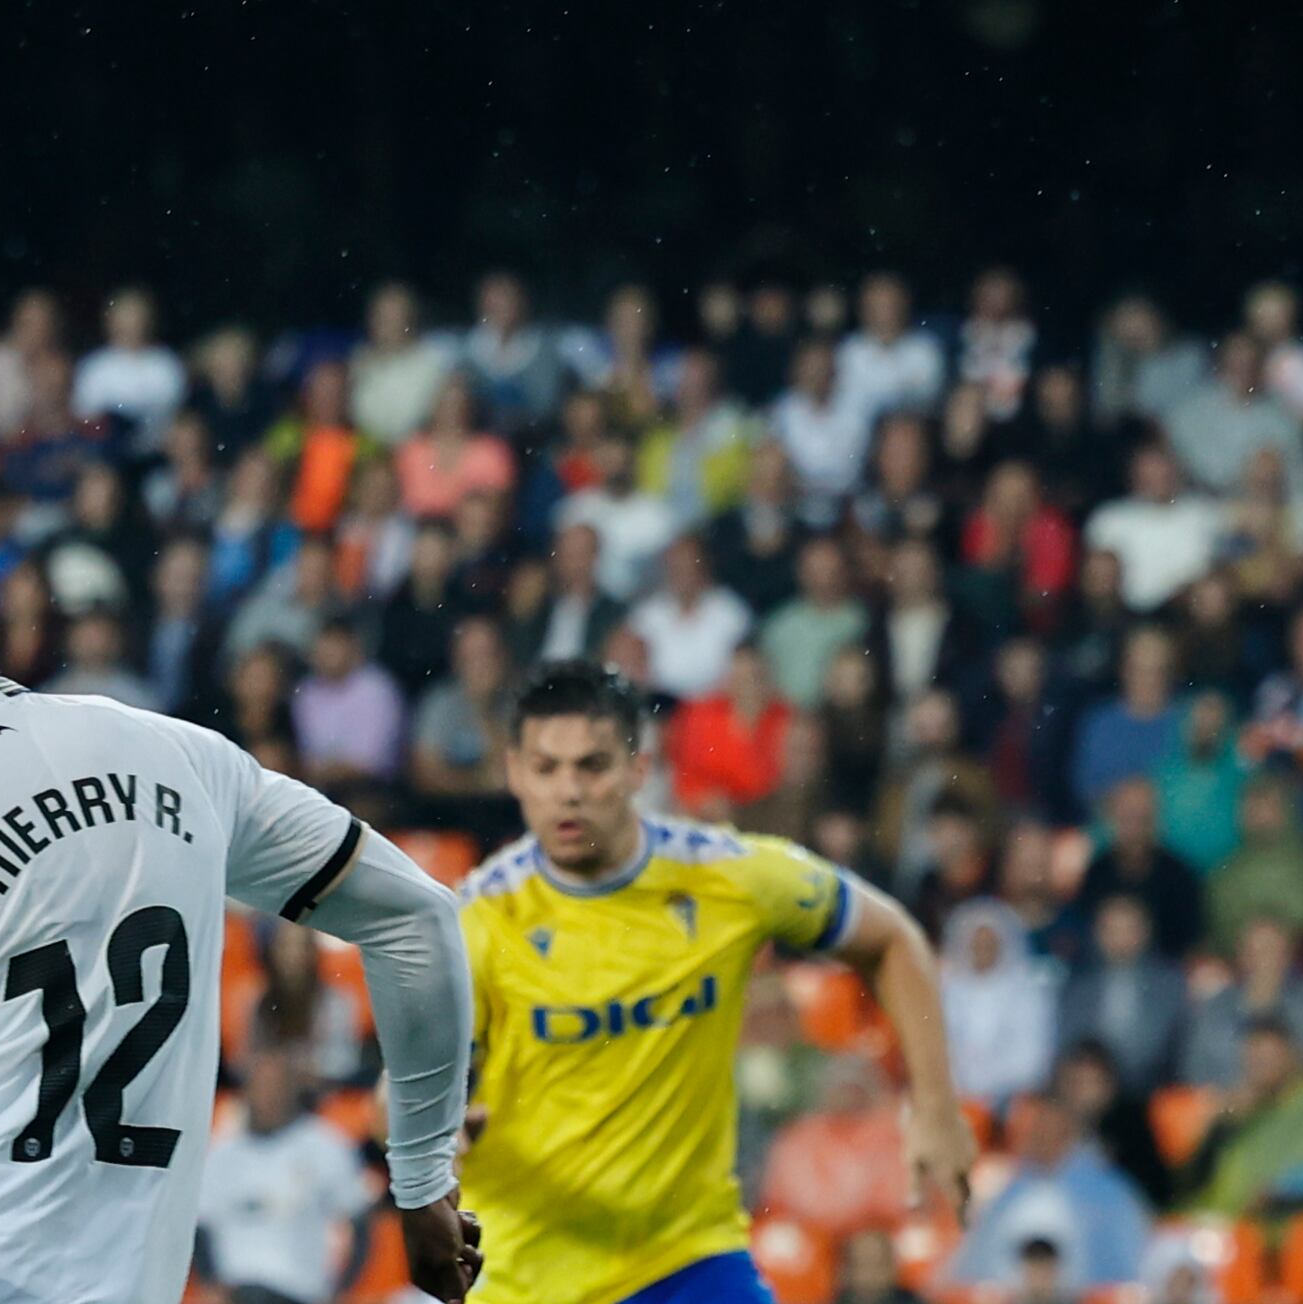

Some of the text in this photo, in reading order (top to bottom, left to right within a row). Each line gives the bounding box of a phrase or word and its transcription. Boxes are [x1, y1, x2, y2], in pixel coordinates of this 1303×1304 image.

[155, 782, 194, 845] R.
[3, 905, 190, 1169] 12
[533, 975, 717, 1045] DIGI
